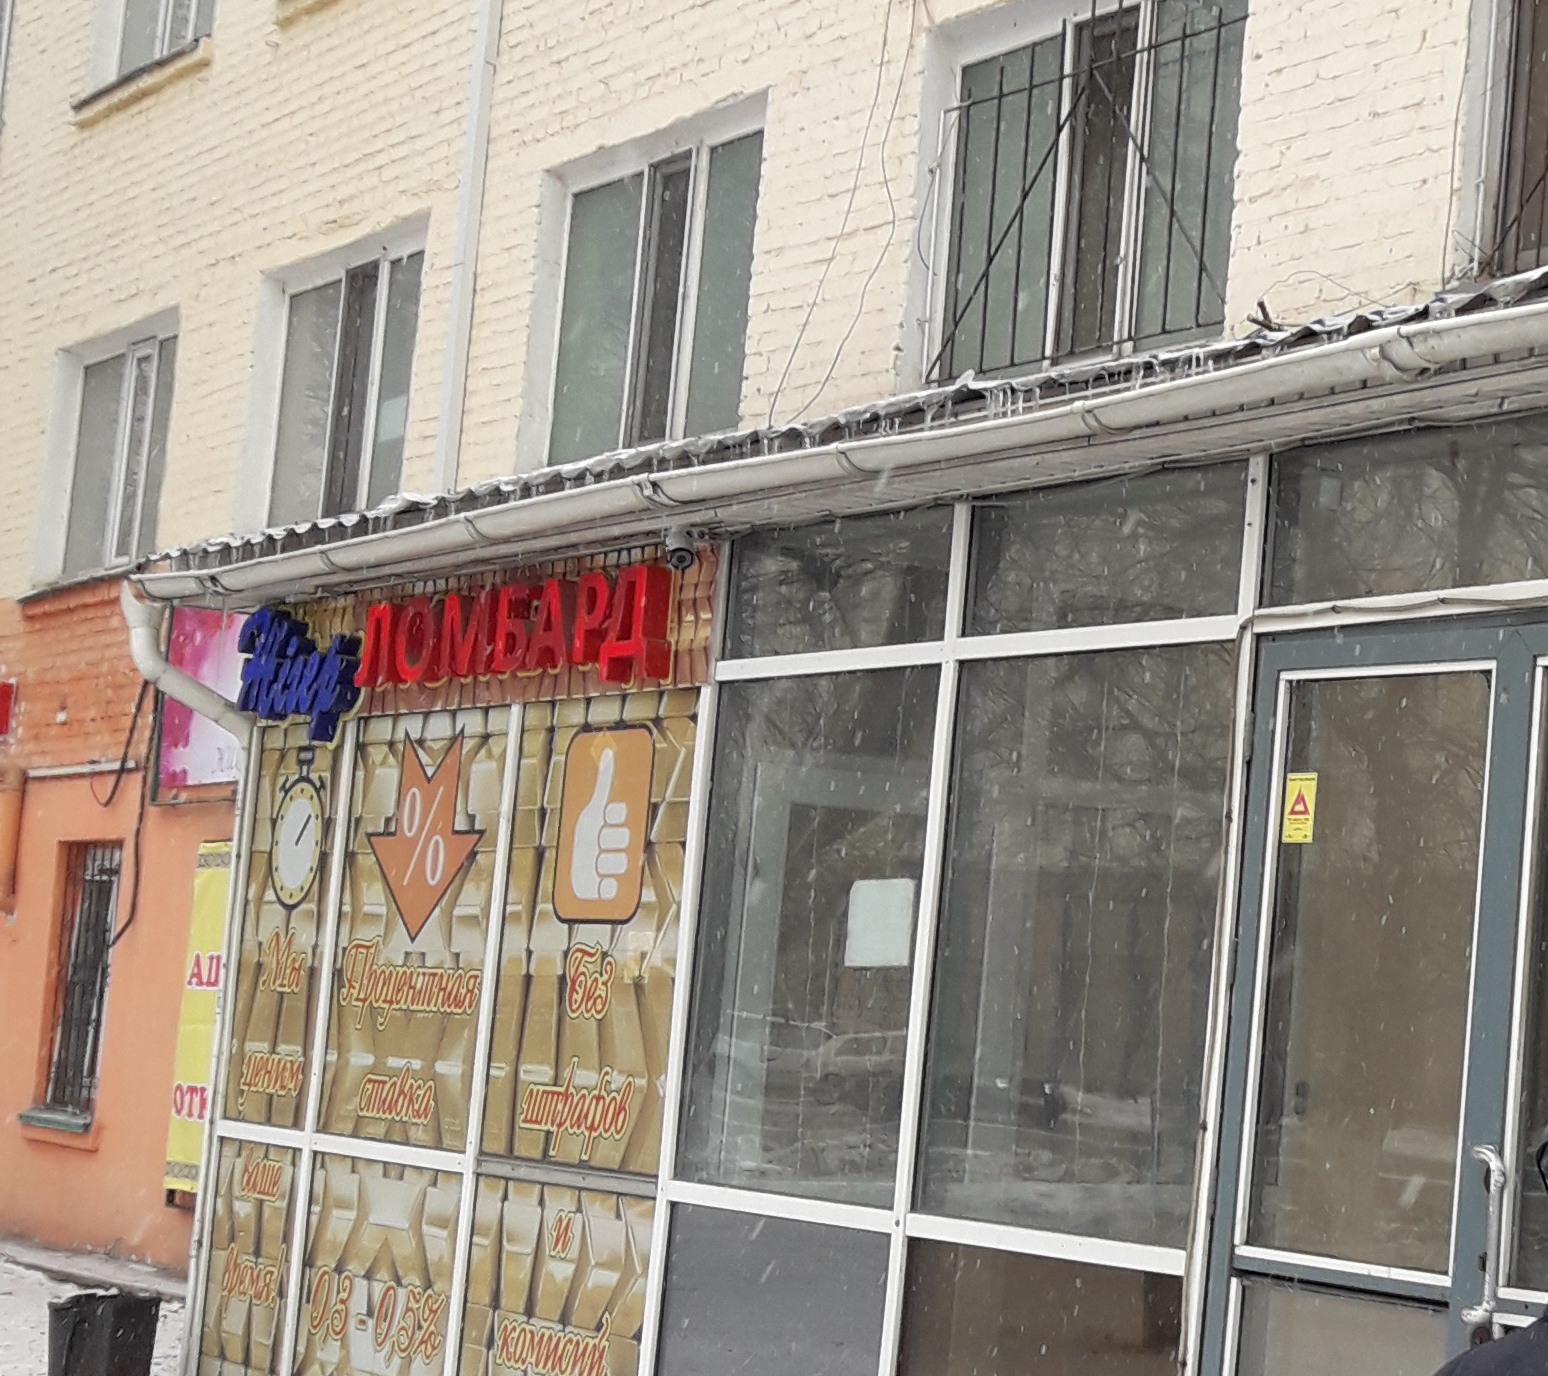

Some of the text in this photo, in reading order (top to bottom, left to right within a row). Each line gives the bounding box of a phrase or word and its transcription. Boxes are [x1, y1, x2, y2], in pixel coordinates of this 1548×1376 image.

[354, 565, 672, 688] ЛОМБАРД
[262, 929, 304, 991] Мы
[341, 938, 481, 1028] Процентная
[567, 945, 615, 1018] Без
[239, 1052, 302, 1109] ценим
[359, 1064, 434, 1123] ставка
[521, 1058, 633, 1158] штрафов
[311, 1268, 352, 1341] 0,3
[375, 1283, 445, 1364] 0,5%
